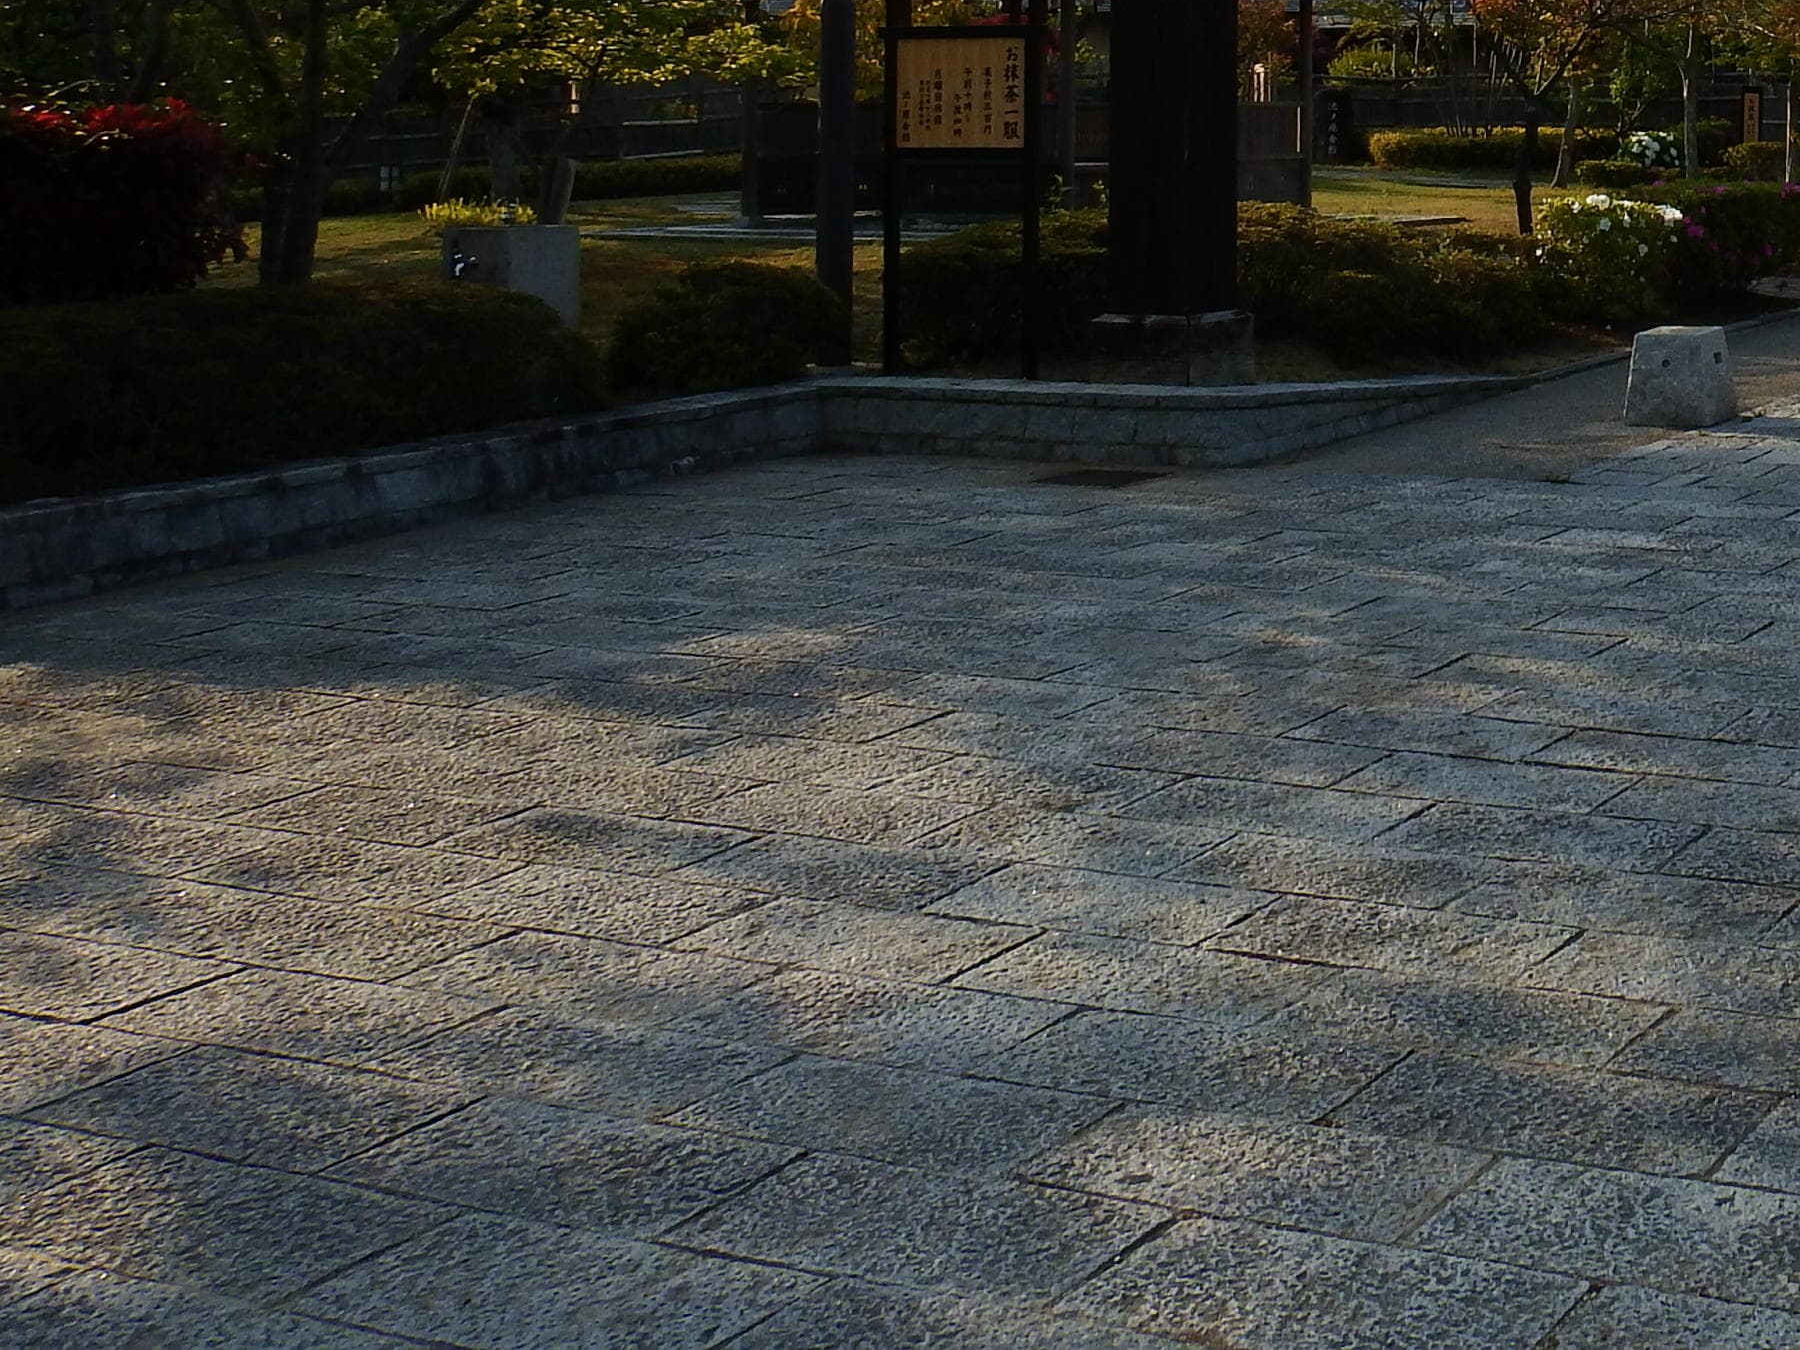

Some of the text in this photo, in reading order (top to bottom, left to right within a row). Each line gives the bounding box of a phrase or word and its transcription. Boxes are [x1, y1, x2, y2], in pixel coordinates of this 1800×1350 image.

[1003, 46, 1020, 140] お抹茶一服
